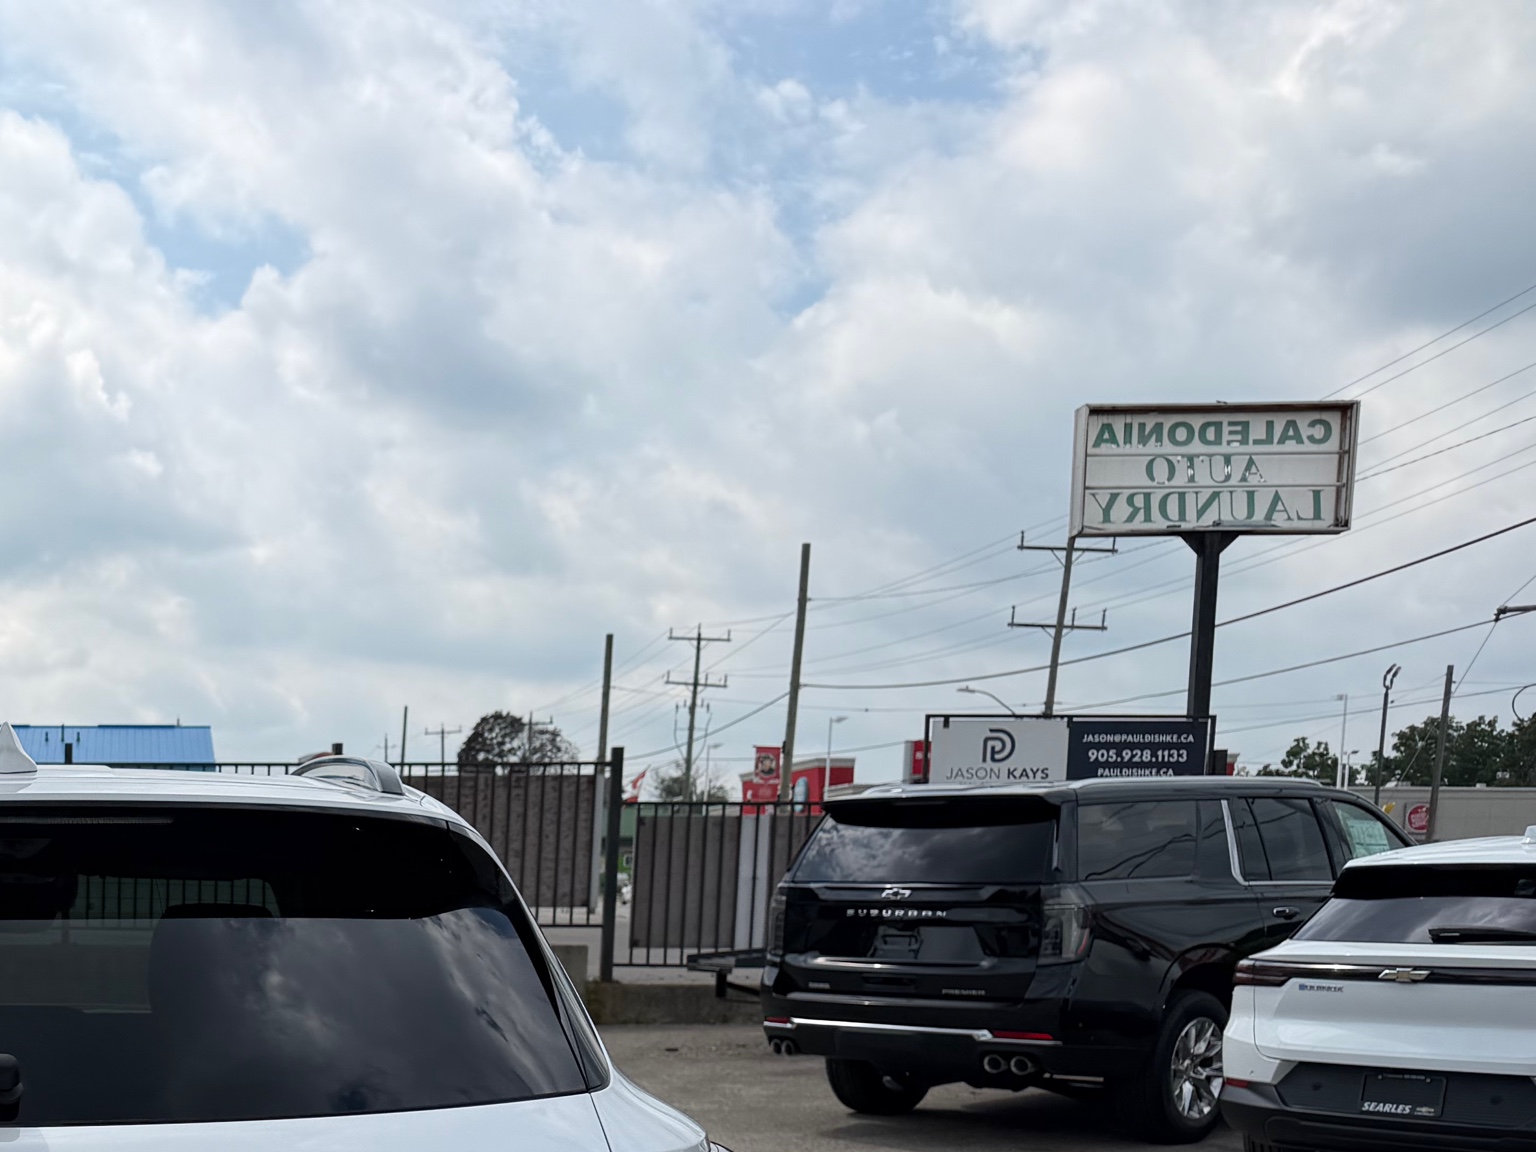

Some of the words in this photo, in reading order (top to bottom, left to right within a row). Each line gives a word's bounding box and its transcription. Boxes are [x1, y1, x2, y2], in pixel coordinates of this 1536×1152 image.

[1082, 733, 1195, 743] JASON@PAULDISHKE.CA
[1088, 748, 1188, 762] 905.928.1133
[946, 766, 1001, 780] JASON
[1007, 767, 1049, 780] KAYS
[1097, 767, 1175, 777] PAULDISHKE.CA
[846, 908, 947, 918] SUBURBAN
[1361, 1101, 1412, 1115] SEARLES
